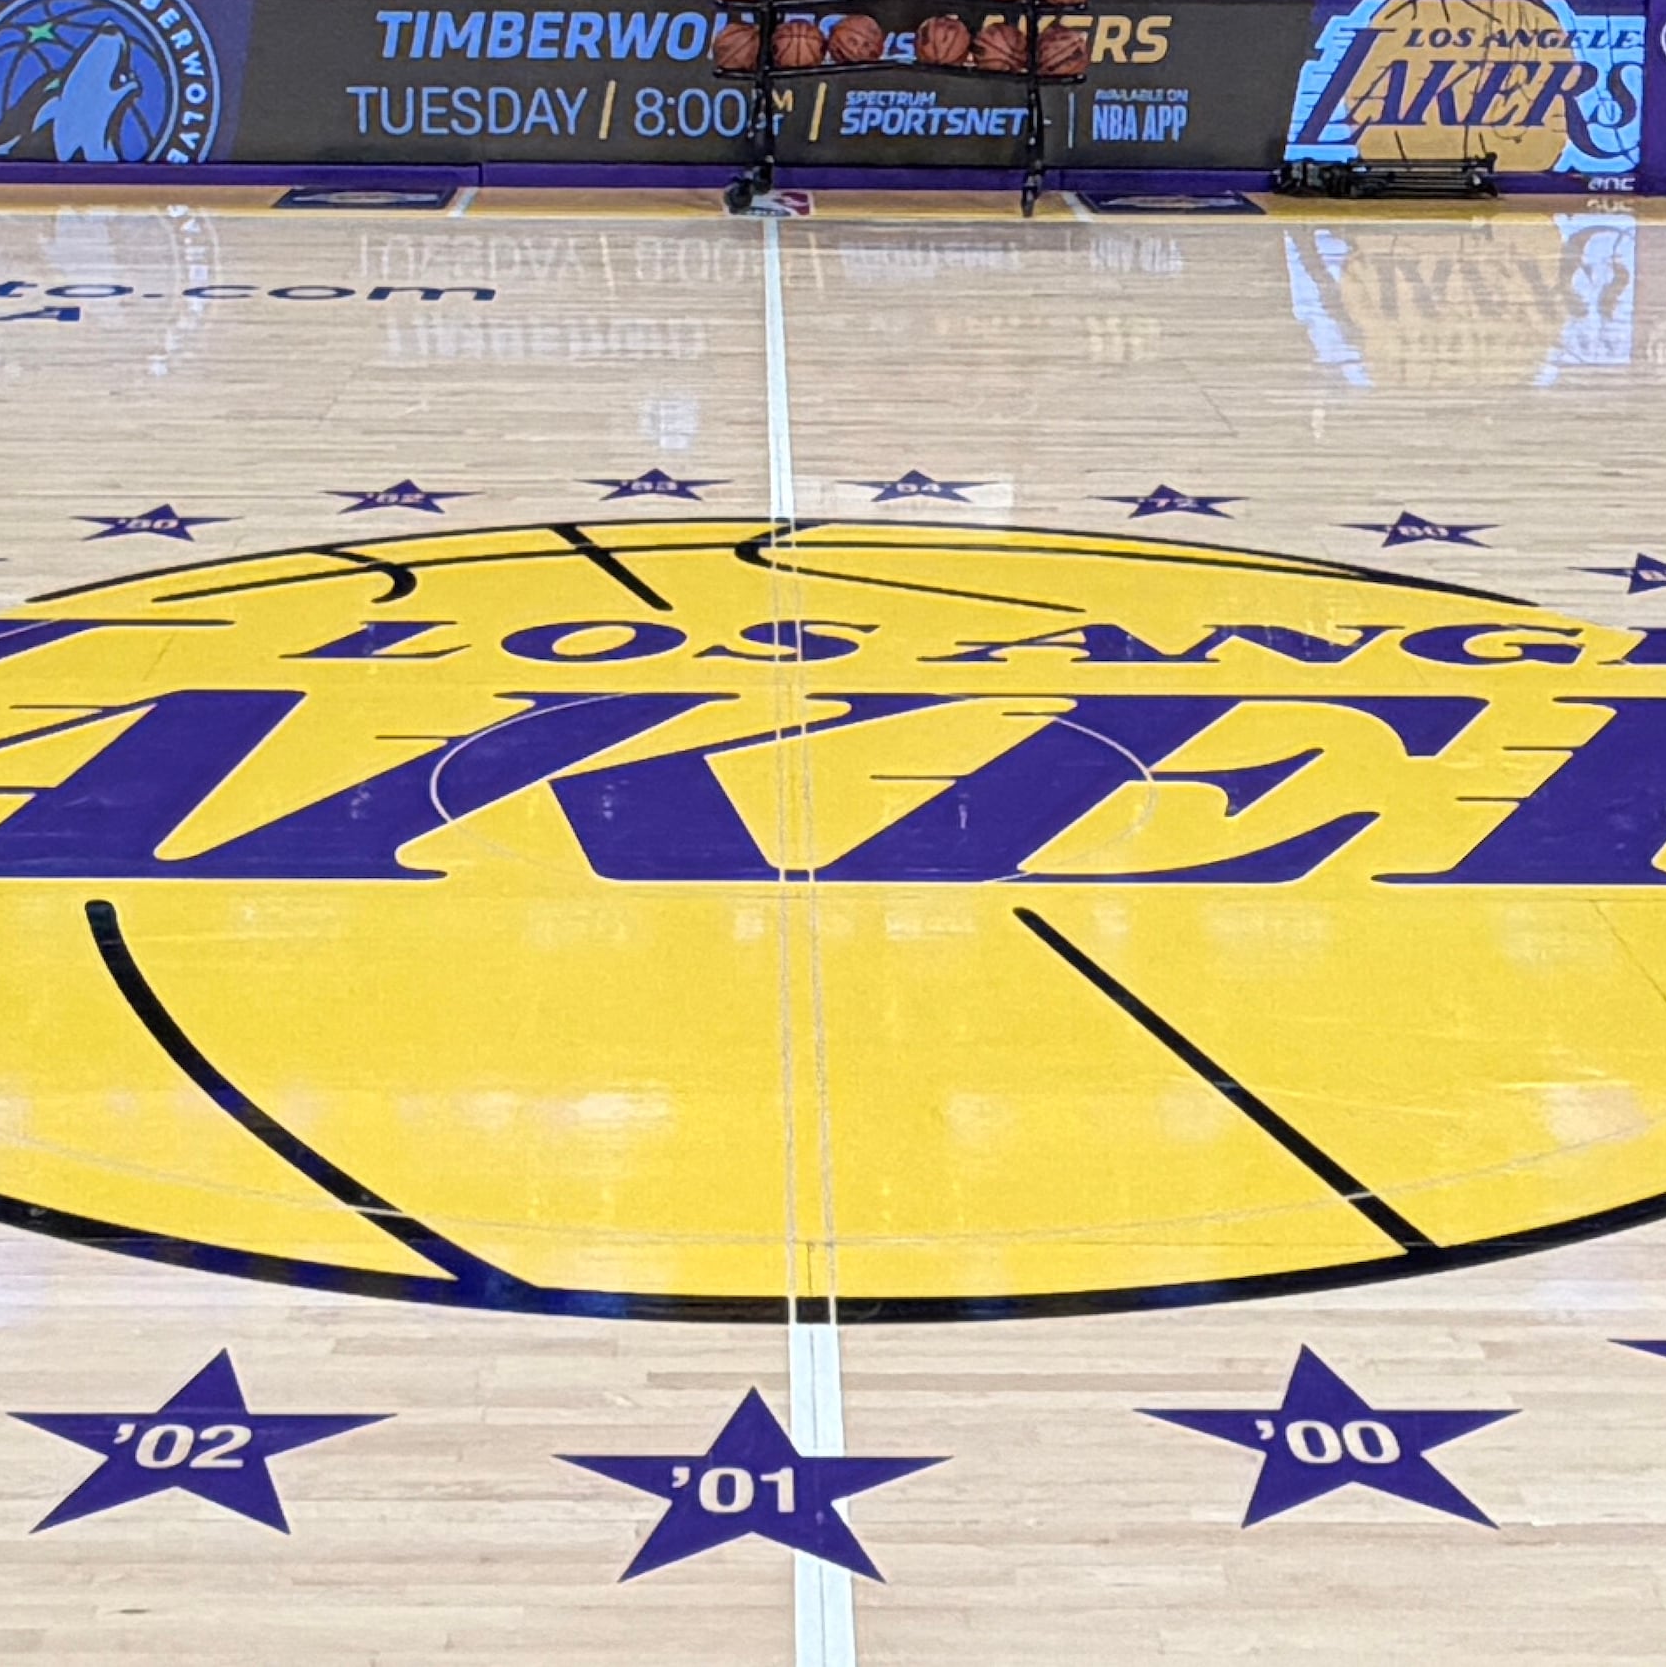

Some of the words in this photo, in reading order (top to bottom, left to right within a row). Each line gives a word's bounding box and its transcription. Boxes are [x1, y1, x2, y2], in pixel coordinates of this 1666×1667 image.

[1404, 26, 1475, 49] LOS
[1479, 26, 1645, 50] ANGELE
[346, 86, 588, 137] TUESDAY
[634, 88, 747, 137] 8:00
[846, 90, 938, 107] SPECTRUM
[1293, 26, 1645, 160] LAKERS
[1092, 104, 1137, 141] NBA
[1141, 104, 1188, 142] APP
[278, 620, 883, 664] LOS
[112, 1422, 253, 1470] '02
[1254, 1418, 1402, 1465] '00
[670, 1465, 796, 1515] '01
